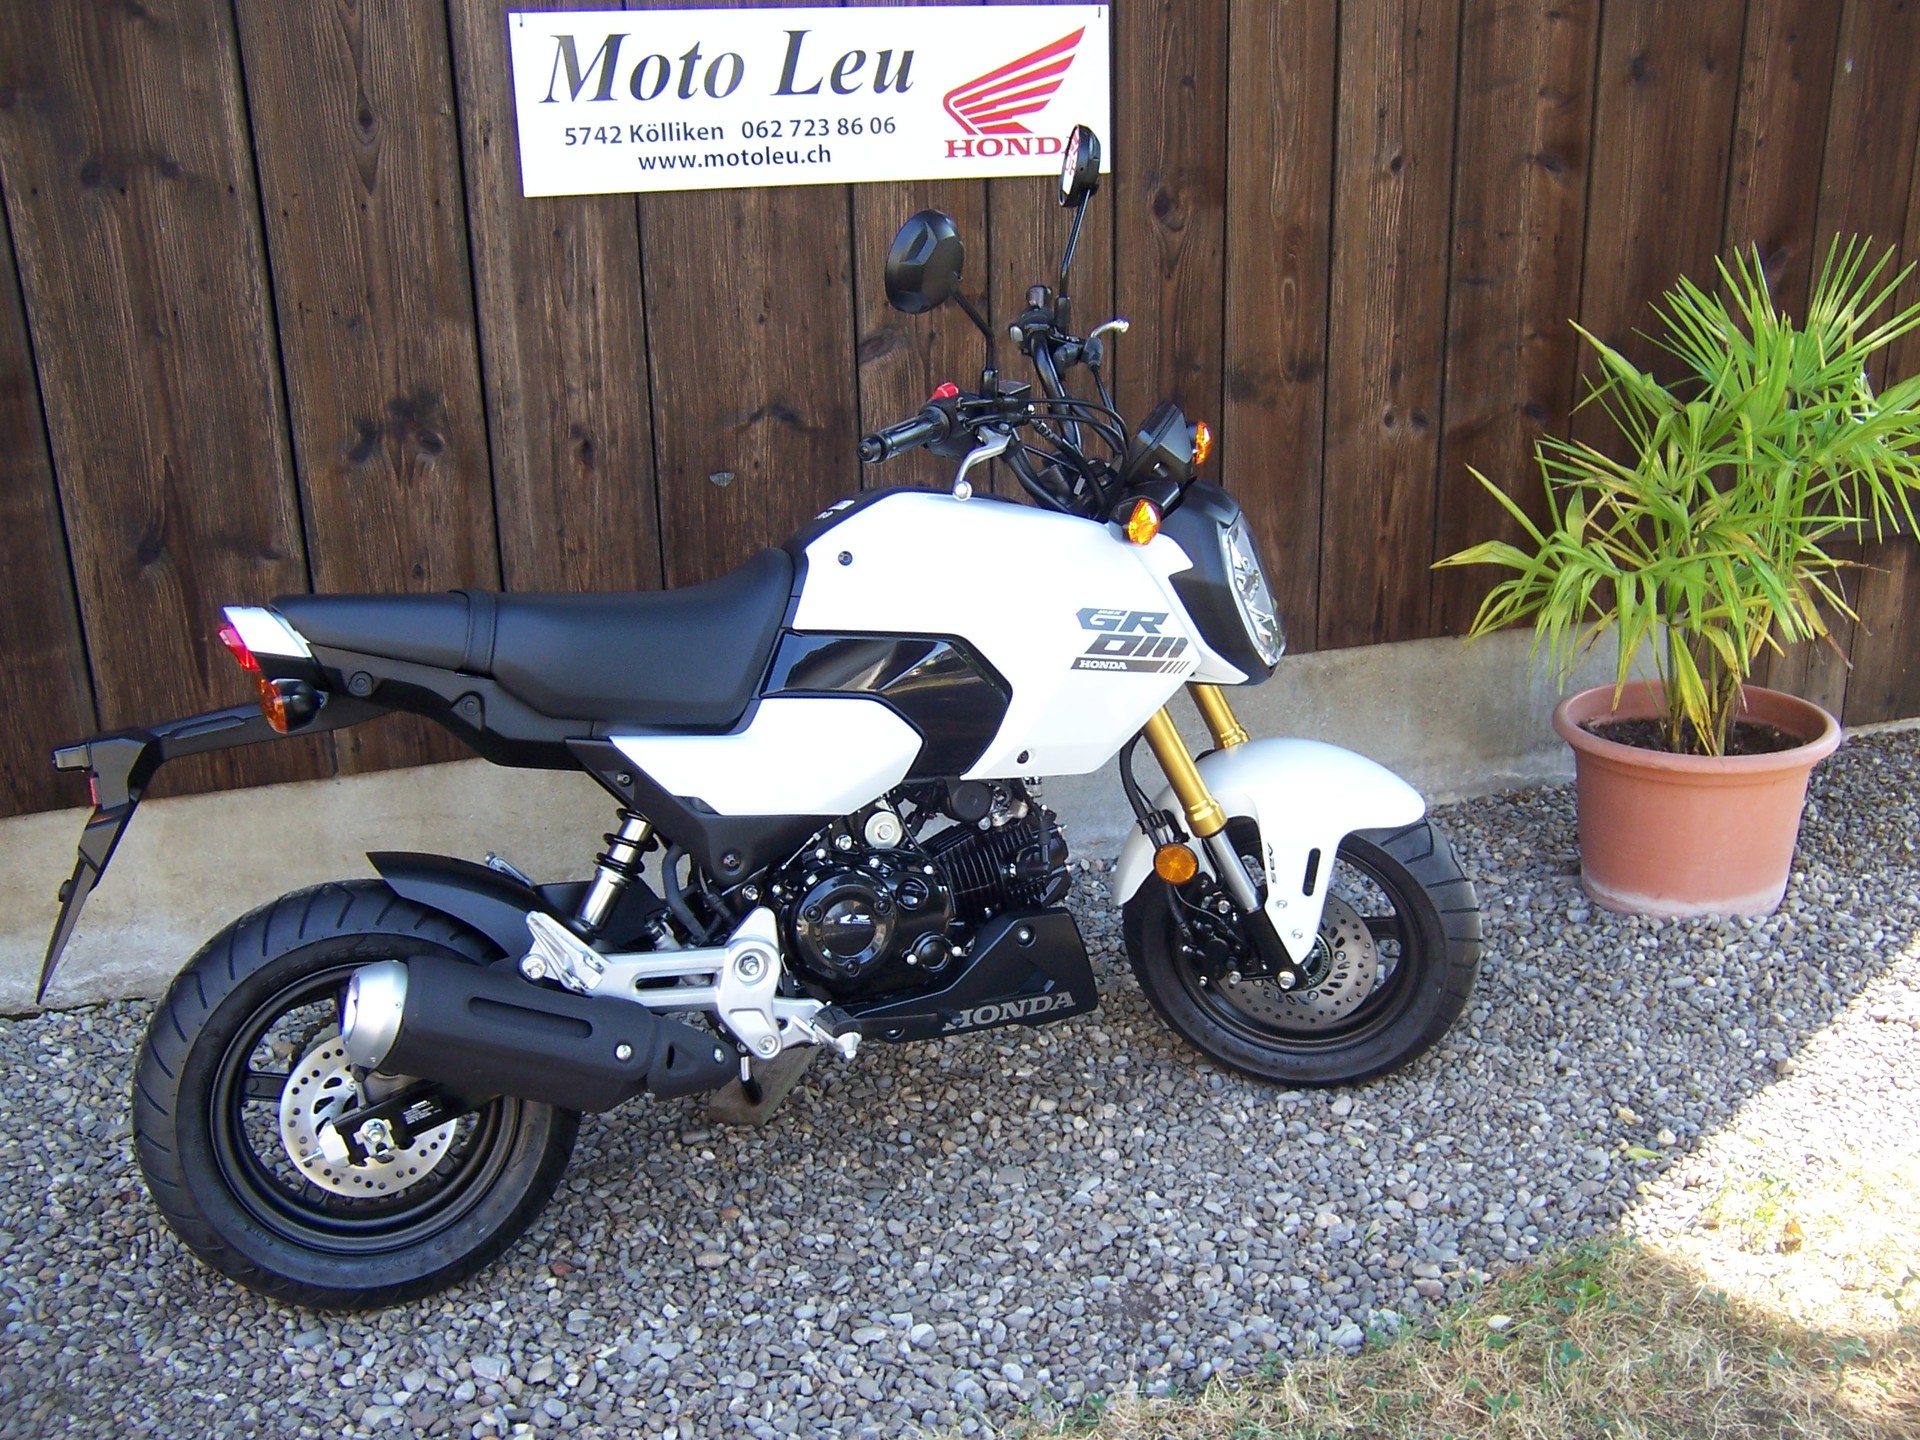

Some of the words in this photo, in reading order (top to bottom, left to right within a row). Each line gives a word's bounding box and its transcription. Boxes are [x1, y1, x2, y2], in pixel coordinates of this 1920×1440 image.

[539, 33, 745, 104] Moto
[770, 29, 915, 97] Leu
[564, 125, 623, 147] 5742
[629, 121, 725, 144] Kölliken
[741, 120, 783, 140] 062
[789, 118, 830, 138] 723
[837, 117, 864, 136] 86
[869, 116, 896, 135] 06
[637, 144, 832, 171] www.motoleu.ch
[944, 136, 1069, 159] HOND
[1078, 659, 1128, 670] HONDA
